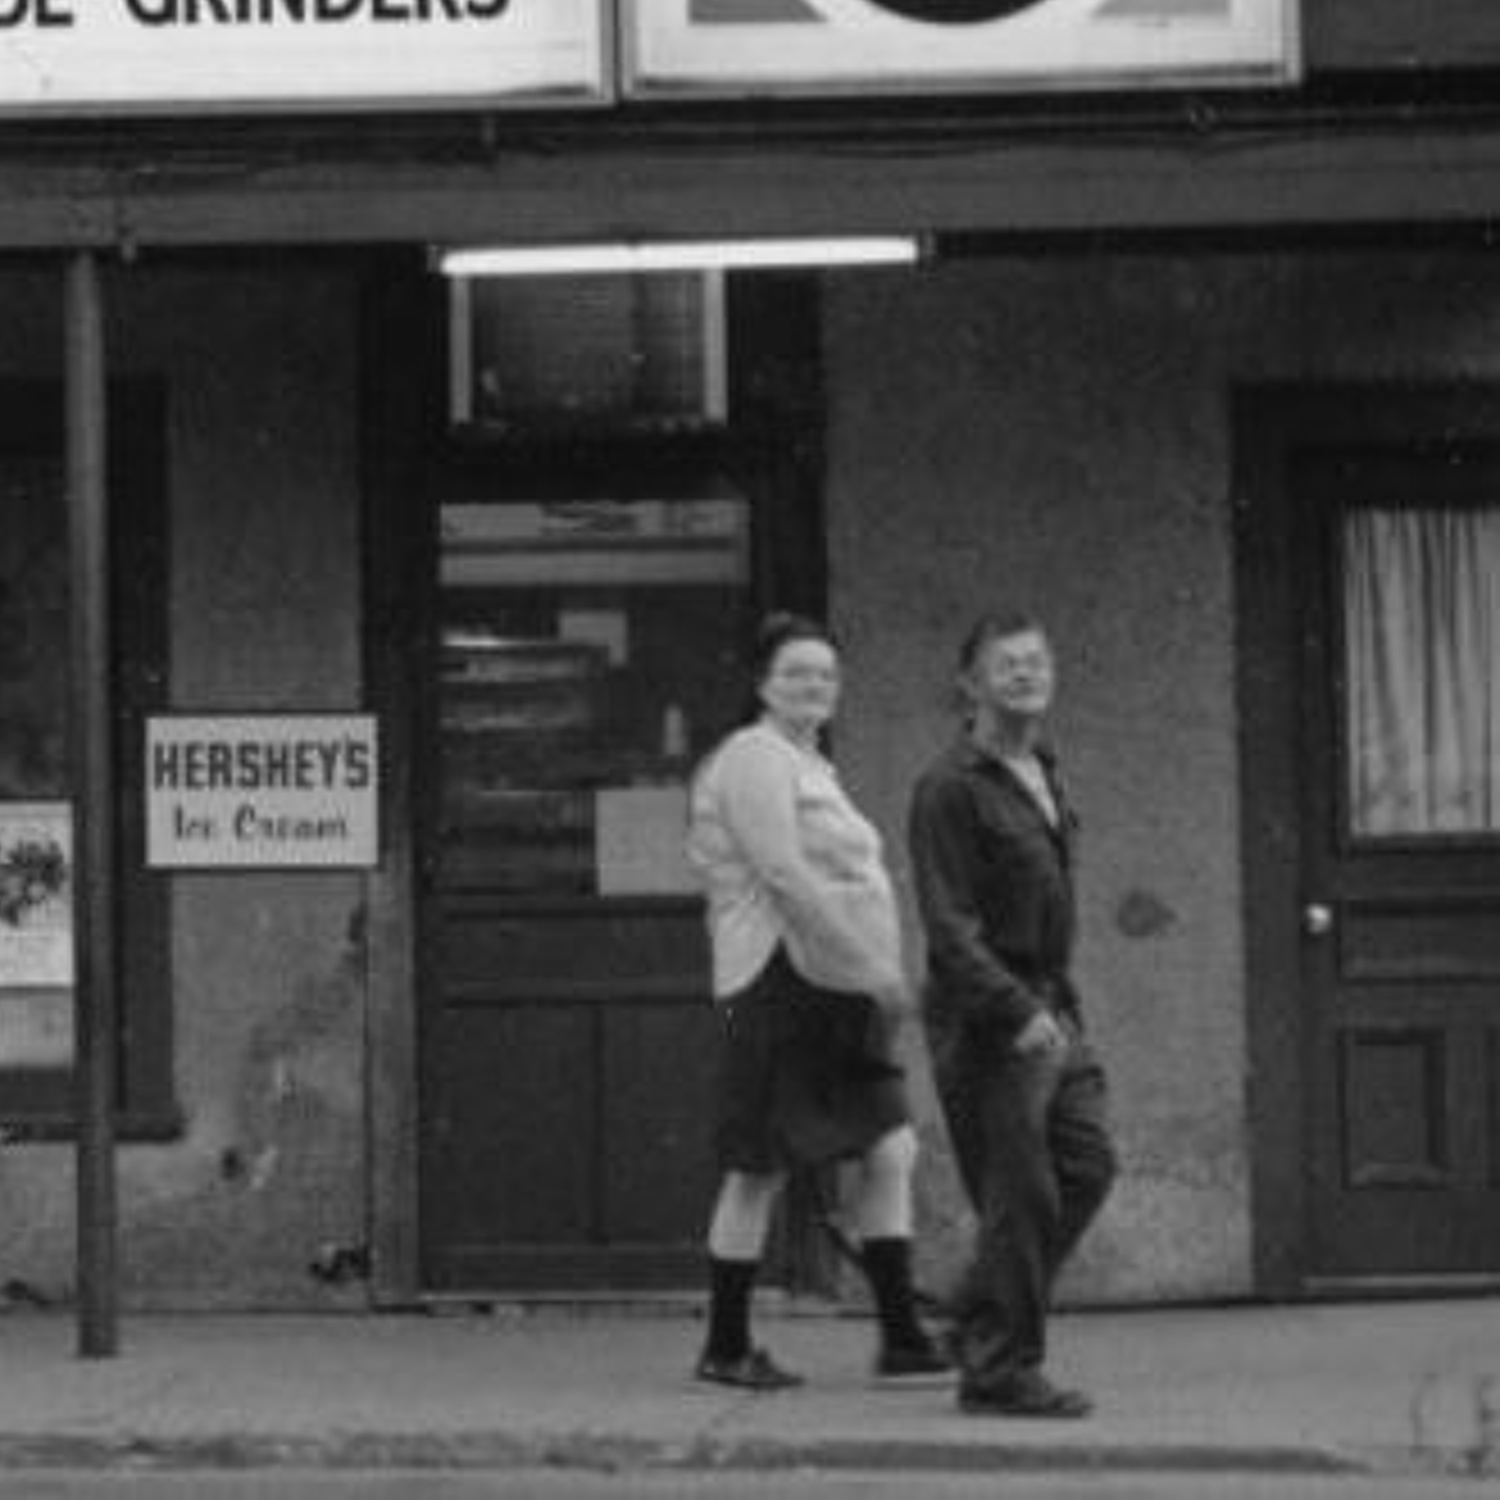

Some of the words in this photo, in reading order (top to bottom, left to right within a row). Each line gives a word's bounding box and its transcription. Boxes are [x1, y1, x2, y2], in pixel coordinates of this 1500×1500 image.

[153, 732, 371, 791] HERSHEY'S
[173, 803, 217, 841] Ice
[233, 802, 349, 842] Cream
